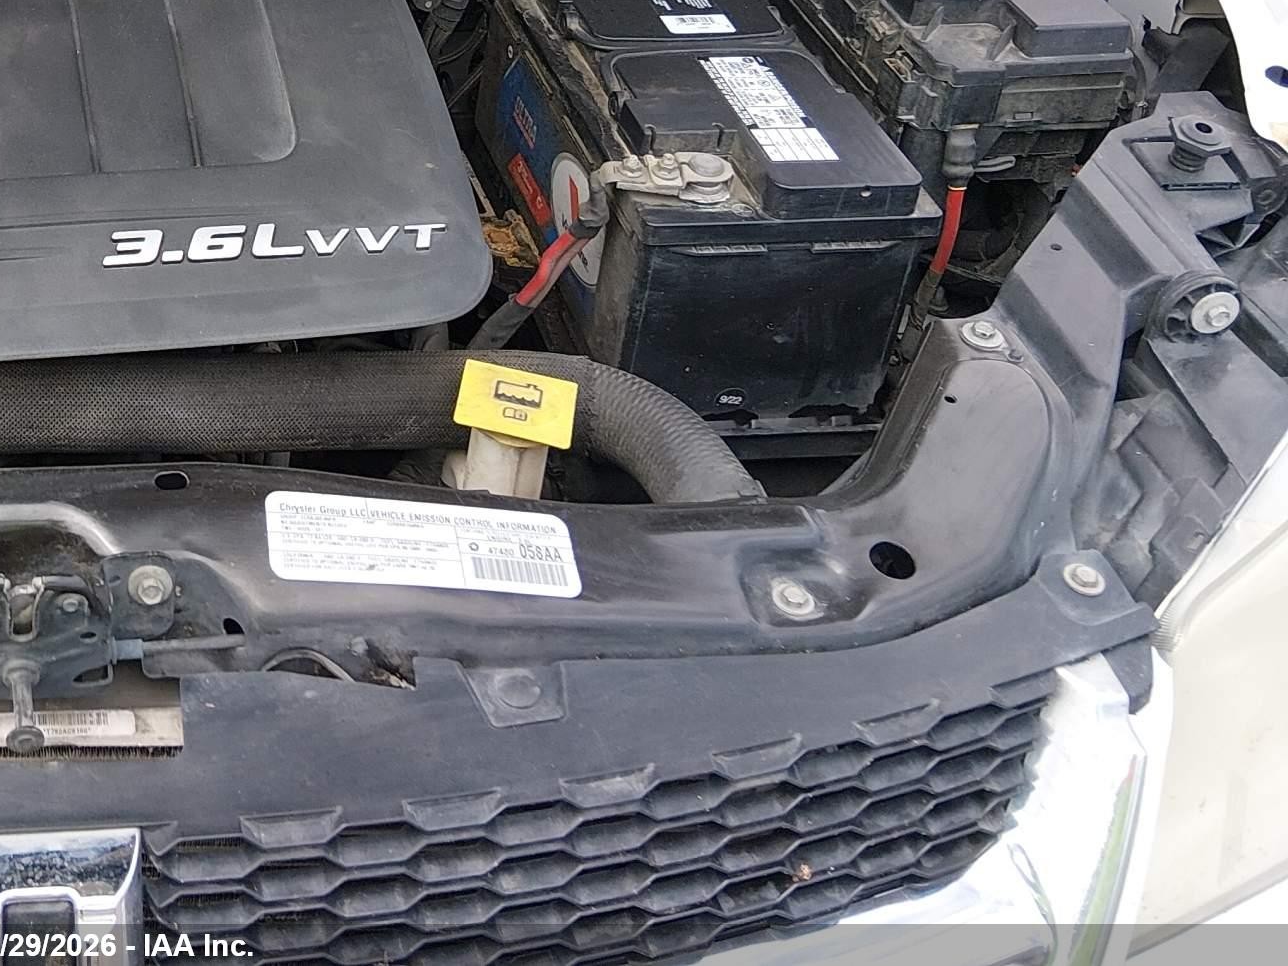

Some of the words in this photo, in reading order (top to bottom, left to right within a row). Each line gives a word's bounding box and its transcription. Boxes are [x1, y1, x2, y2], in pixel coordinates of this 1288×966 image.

[718, 395, 743, 405] 9/22
[279, 502, 317, 516] Chrysler
[319, 505, 347, 518] Group
[349, 506, 367, 517] LLC
[370, 509, 406, 521] VEHICLE
[409, 512, 451, 525] EMISSION
[453, 516, 493, 529] CONTROL
[495, 520, 557, 534] INFORMATION
